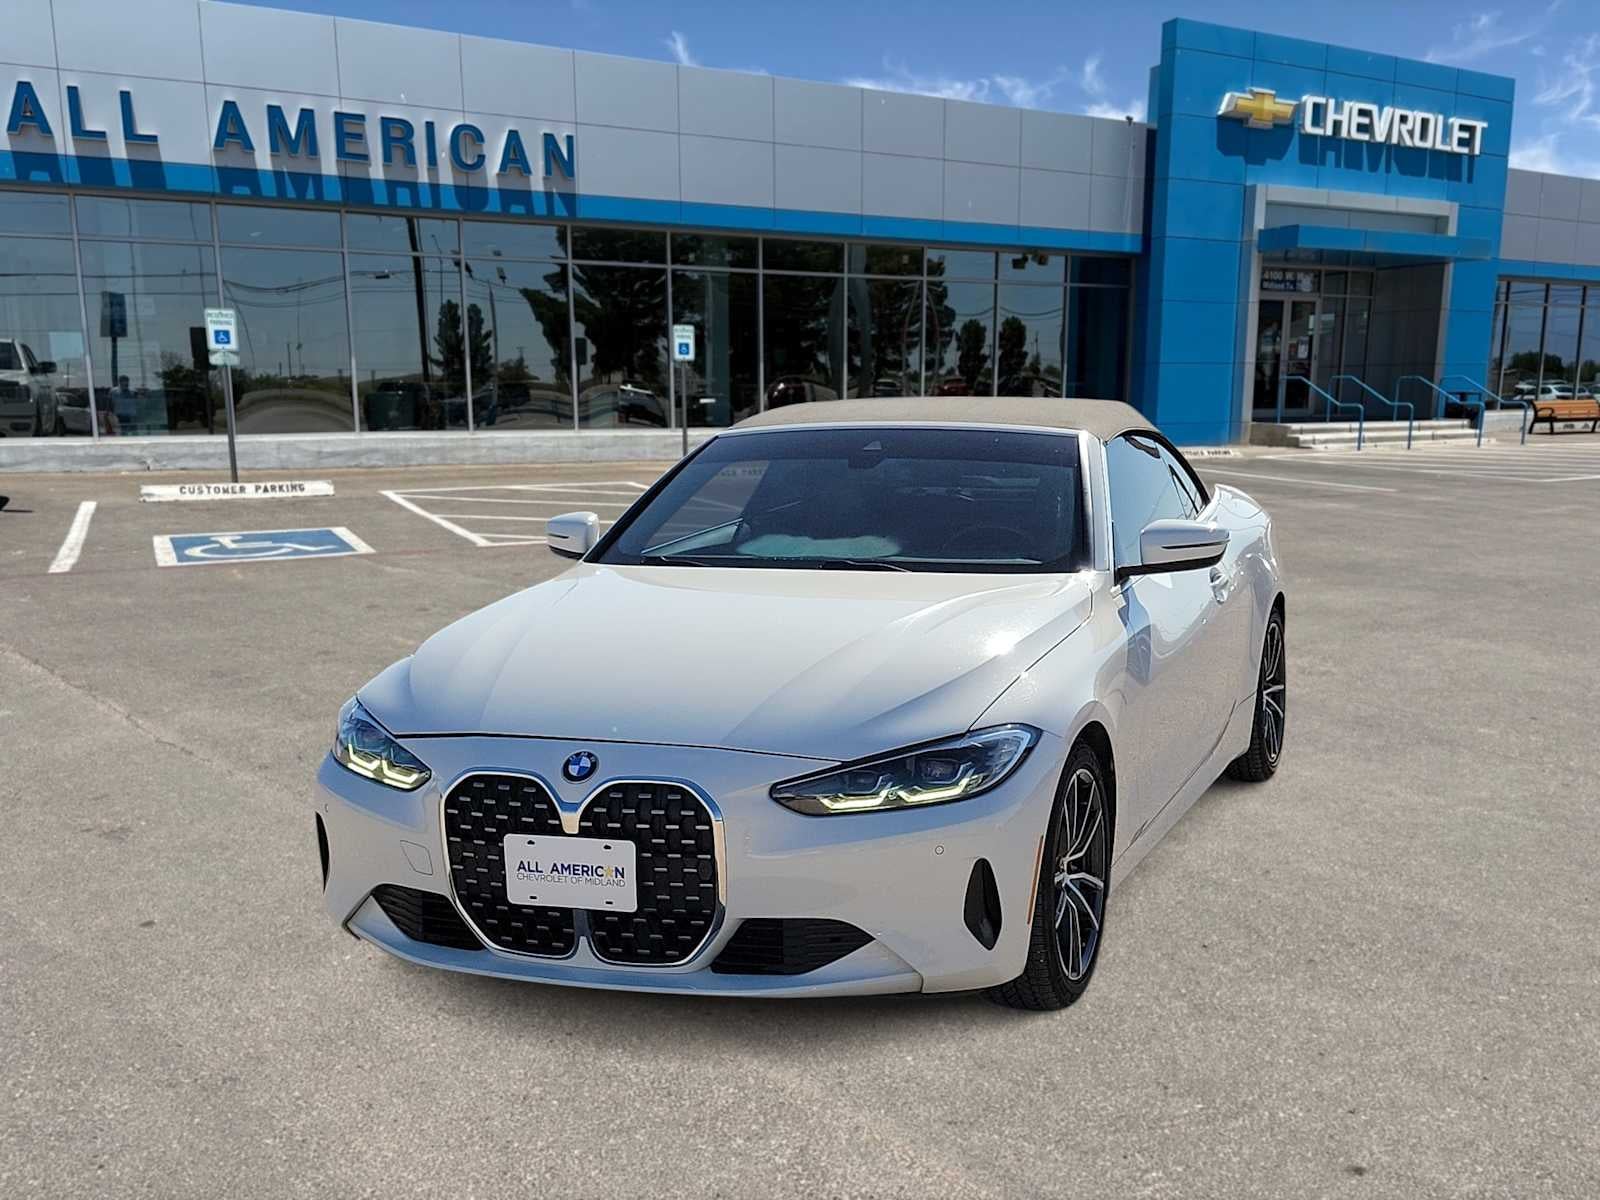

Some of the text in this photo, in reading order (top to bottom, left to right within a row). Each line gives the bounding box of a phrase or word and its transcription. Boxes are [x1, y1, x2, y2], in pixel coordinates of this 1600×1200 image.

[6, 80, 576, 180] ALL AMERICAN
[1301, 94, 1488, 156] CHEVROLET
[179, 483, 305, 495] CUSTOMER PARKING
[517, 860, 625, 879] ALL AMERICN
[516, 872, 626, 888] CHEVROLET OF MIDLAND
